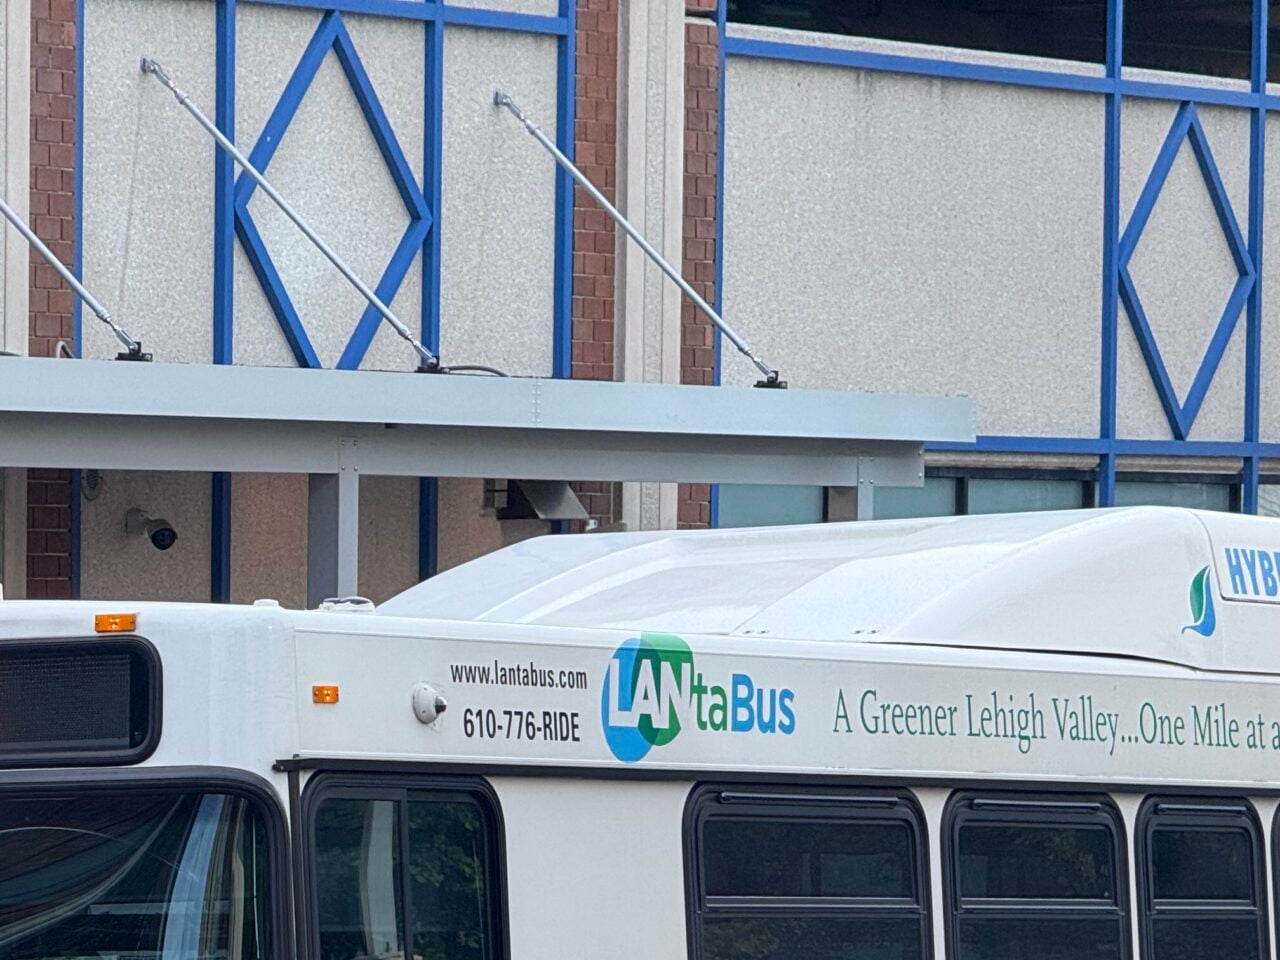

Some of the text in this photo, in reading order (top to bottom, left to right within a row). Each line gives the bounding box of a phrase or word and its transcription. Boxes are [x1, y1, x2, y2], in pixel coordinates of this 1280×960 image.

[450, 659, 588, 690] www.lantabus.com
[608, 656, 796, 736] LANtaBus
[463, 708, 581, 743] 610-776-RIDE
[832, 687, 853, 733] A
[859, 689, 958, 738] Greener
[964, 691, 1047, 755] Lehigh
[1191, 703, 1240, 749] Mile
[1246, 715, 1266, 750] at
